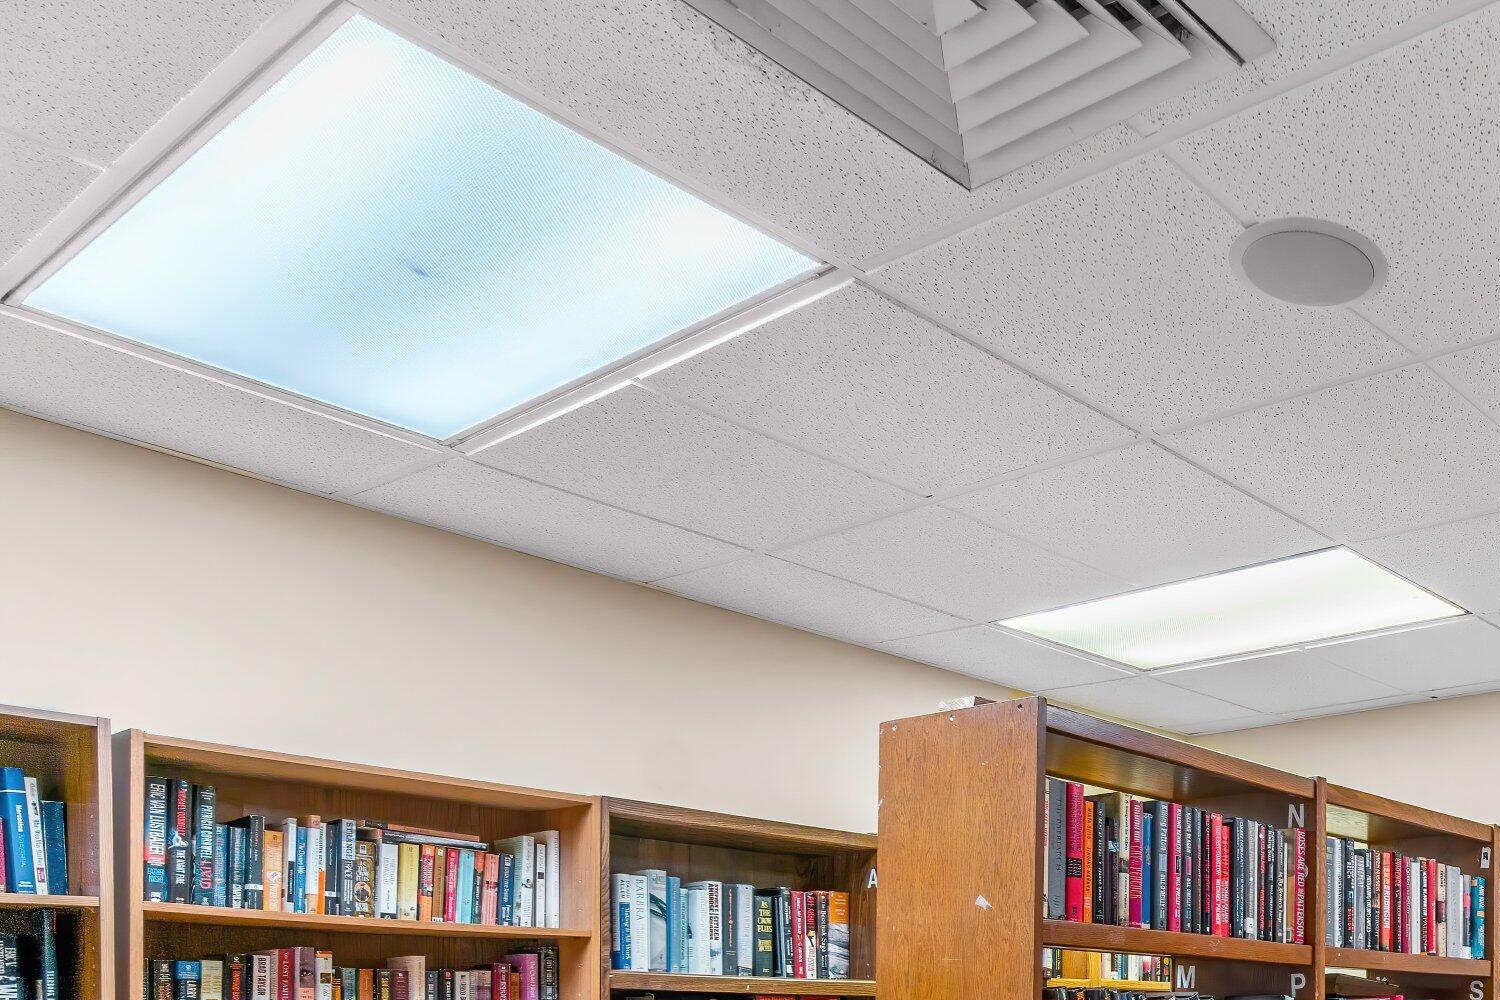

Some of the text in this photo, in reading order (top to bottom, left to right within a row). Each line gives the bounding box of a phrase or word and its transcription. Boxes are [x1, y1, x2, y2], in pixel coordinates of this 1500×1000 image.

[149, 783, 166, 855] ERIC VAN LUSTBADER
[1160, 804, 1168, 850] Killing Patton
[1288, 803, 1306, 828] N
[200, 805, 213, 889] PATRICIA CORNWELL LIVID
[868, 869, 878, 888] A
[1297, 831, 1305, 937] ROSES ARE RED PATTERSON
[635, 879, 645, 921] BARBRA
[186, 981, 196, 998] LARRY
[257, 958, 267, 996] BRAD TAYLOR
[1176, 965, 1196, 989] M
[1290, 973, 1306, 997] P
